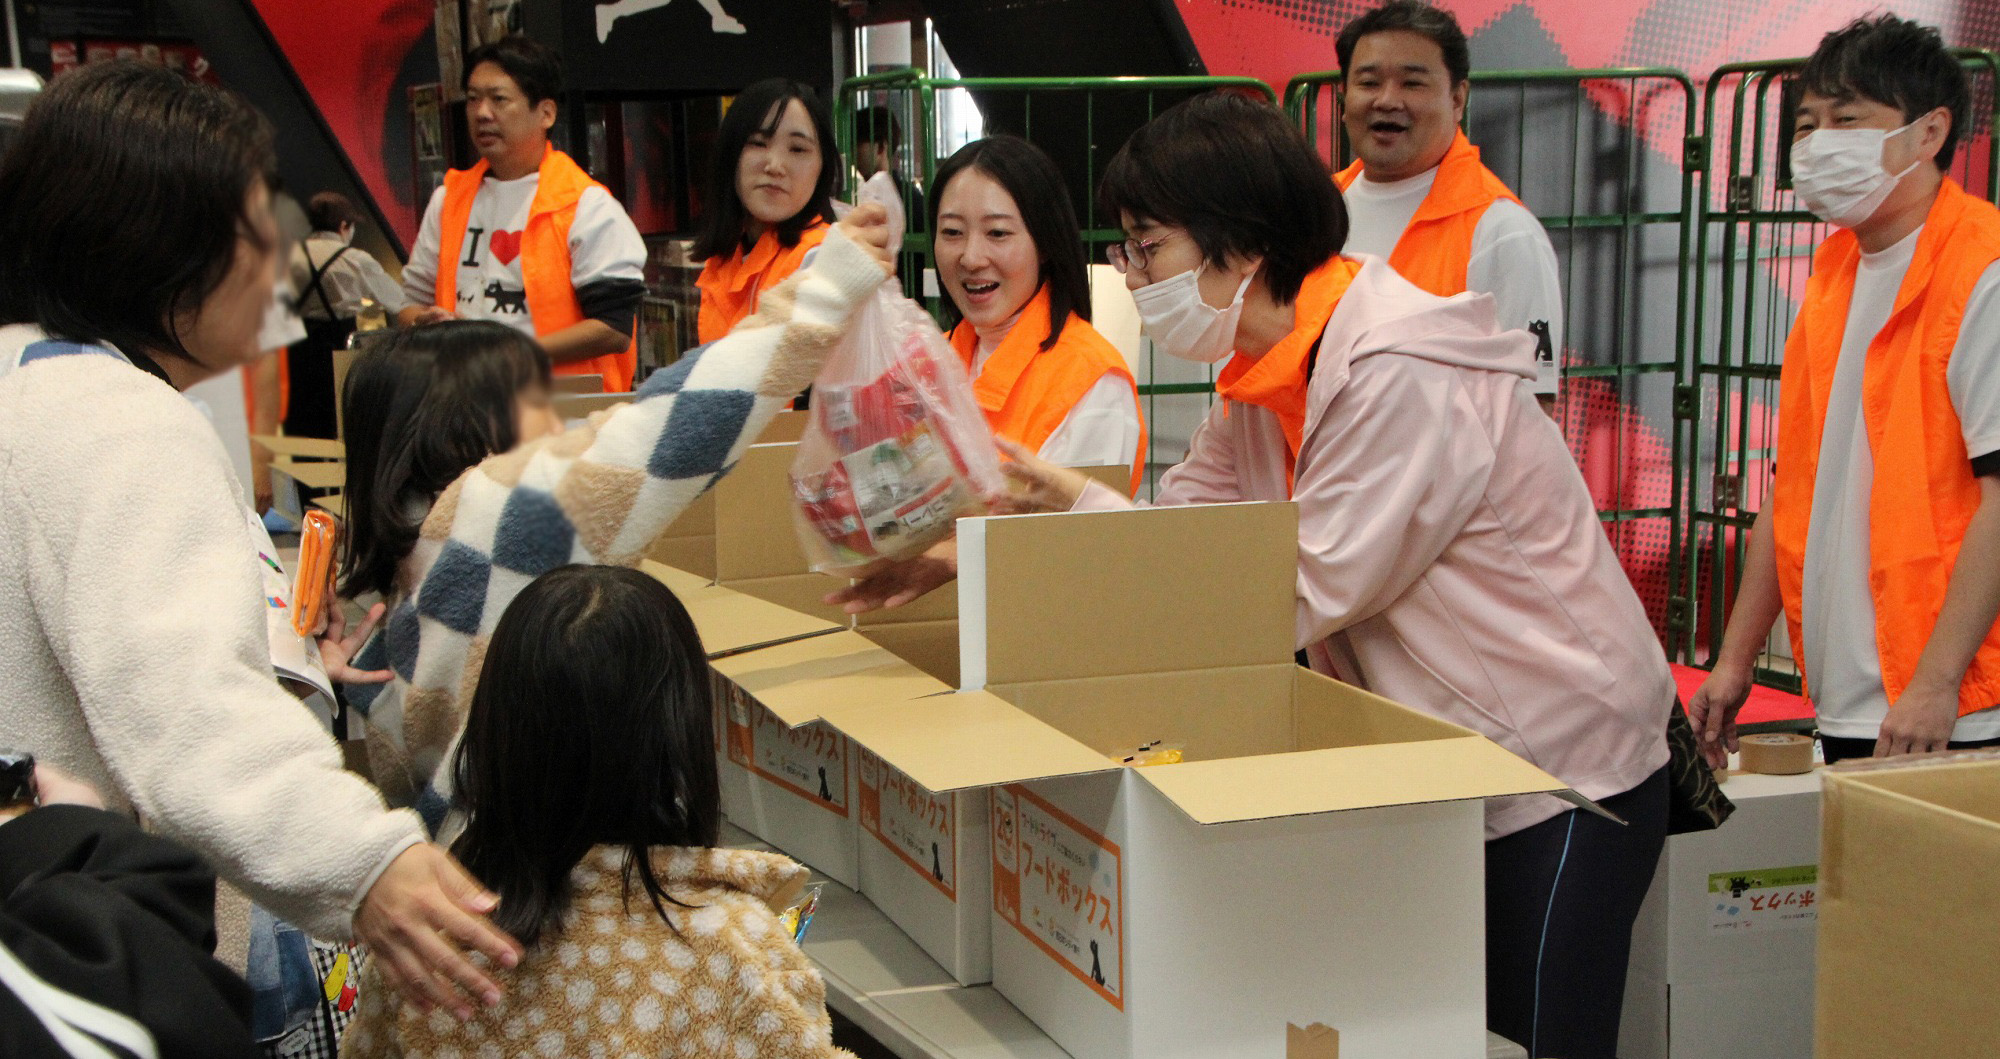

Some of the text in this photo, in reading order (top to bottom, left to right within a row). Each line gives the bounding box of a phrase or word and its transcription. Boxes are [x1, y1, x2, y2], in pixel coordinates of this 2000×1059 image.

[462, 227, 484, 267] I
[1022, 841, 1113, 936] フードボックス
[1750, 890, 1815, 911] ボックス
